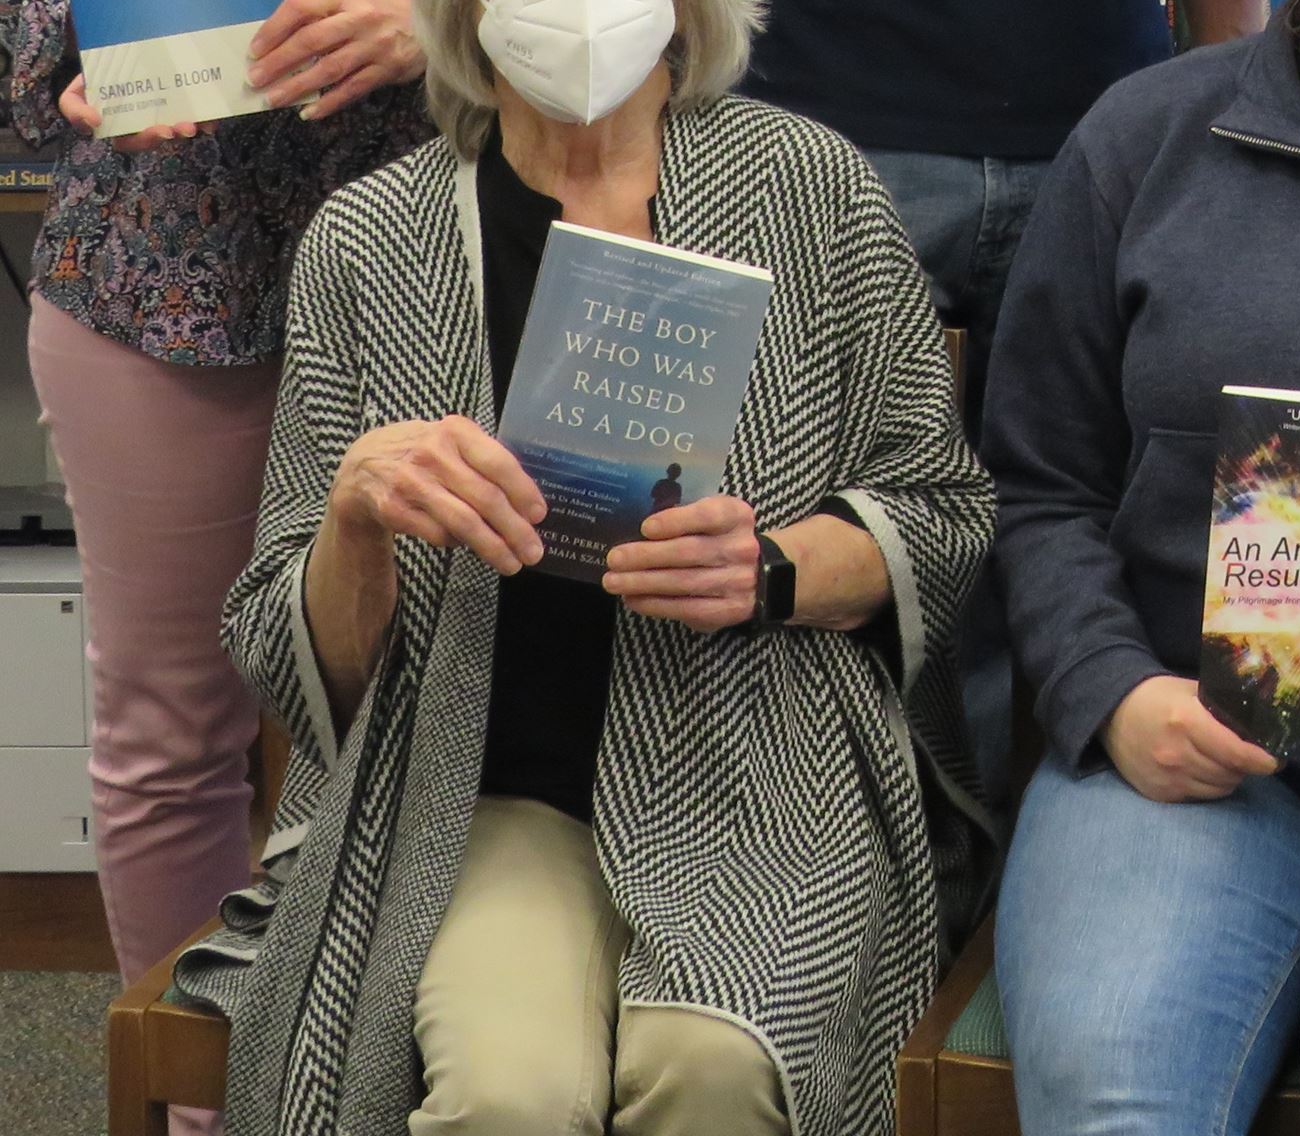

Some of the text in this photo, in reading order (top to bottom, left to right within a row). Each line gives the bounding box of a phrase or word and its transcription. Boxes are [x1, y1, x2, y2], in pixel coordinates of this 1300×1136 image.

[99, 66, 222, 101] SANDRA BLOOM
[137, 98, 168, 110] EDITION
[604, 250, 635, 265] Revised
[655, 263, 689, 279] Updated
[582, 298, 717, 349] THE BOY
[564, 330, 717, 387] WHO WAS
[572, 370, 687, 415] RAISED
[544, 401, 586, 428] AS
[593, 413, 612, 435] A
[624, 419, 695, 454] DOG
[571, 498, 593, 509] About
[567, 510, 597, 523] Healing
[560, 534, 571, 544] D.
[1221, 537, 1261, 562] An
[548, 546, 577, 561] MAIA
[1222, 596, 1235, 605] My
[1238, 595, 1283, 605] Pilgrimage
